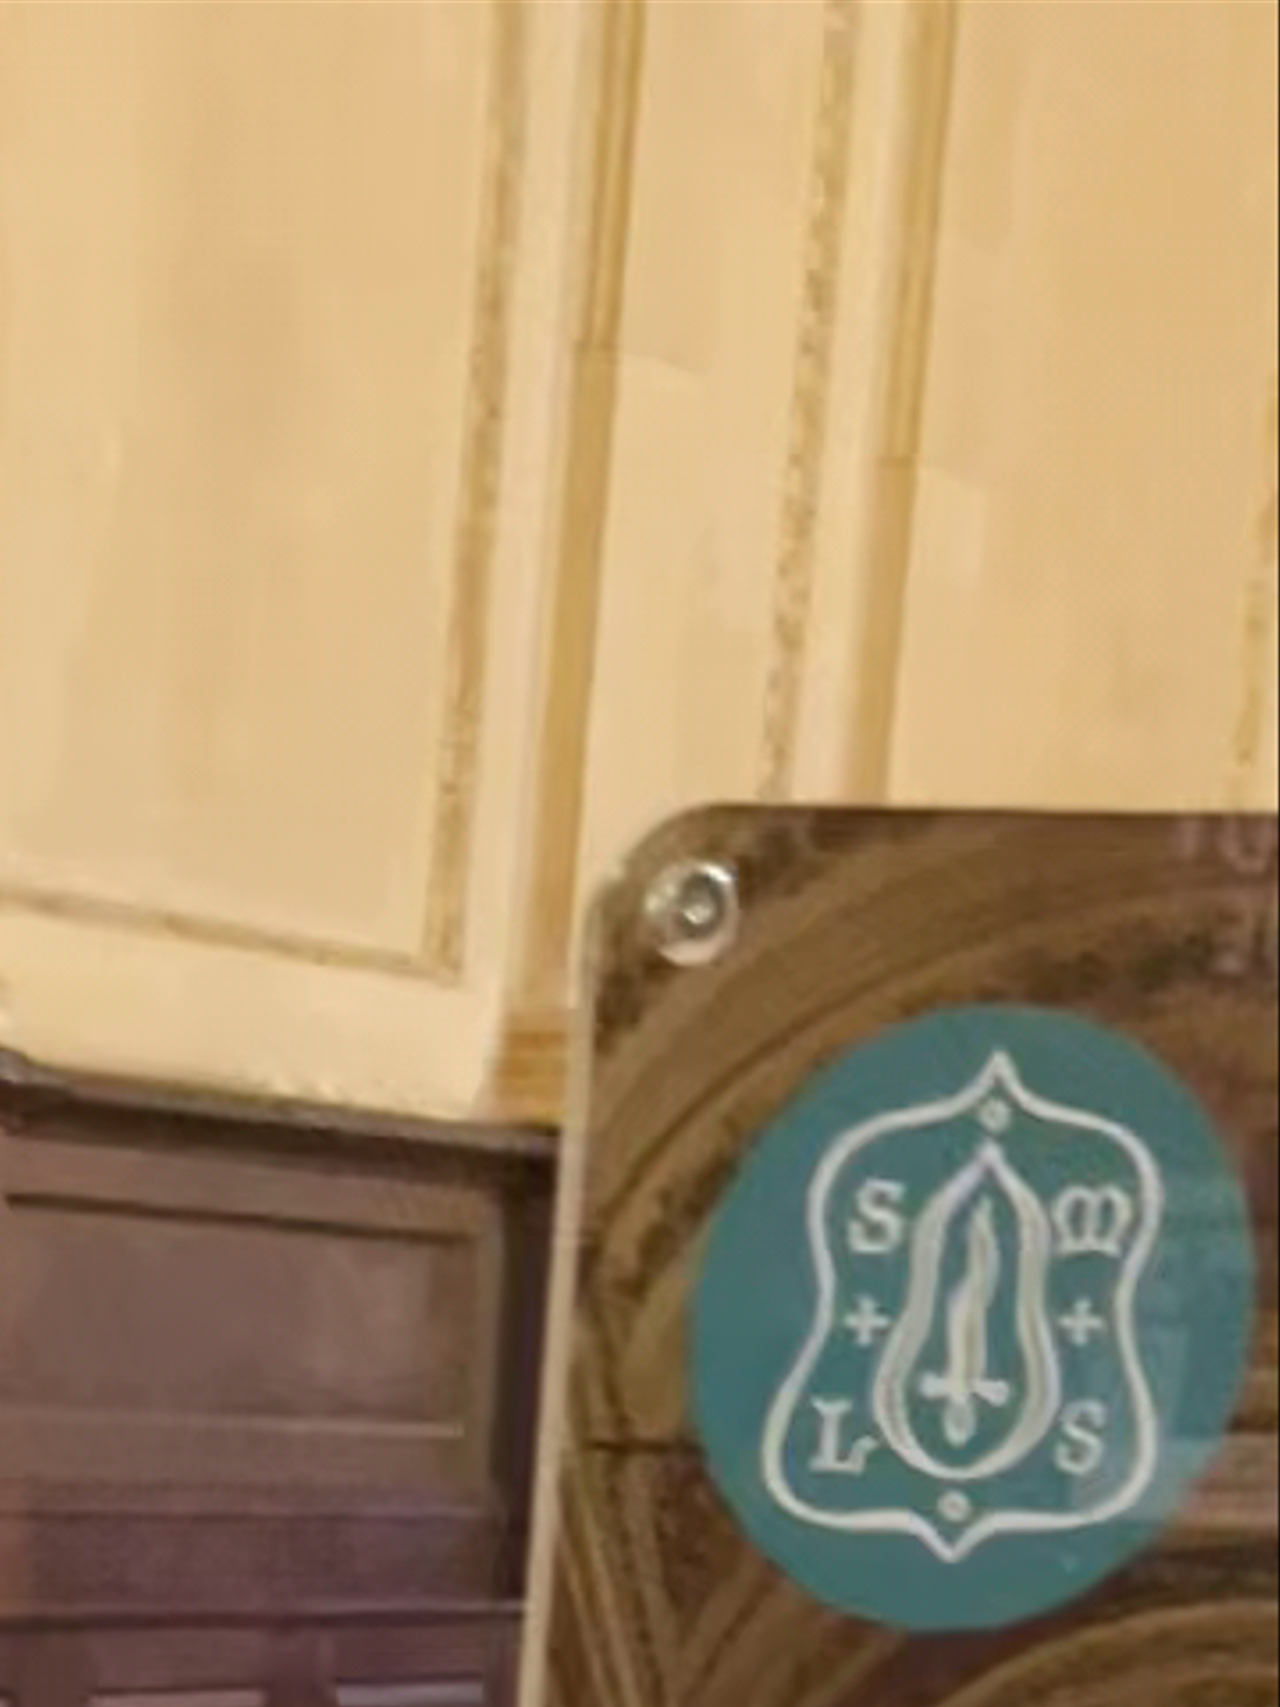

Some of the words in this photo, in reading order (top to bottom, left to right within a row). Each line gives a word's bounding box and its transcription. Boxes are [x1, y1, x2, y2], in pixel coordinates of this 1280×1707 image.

[848, 1177, 906, 1254] S
[809, 1397, 878, 1475] L
[1053, 1398, 1107, 1475] S
